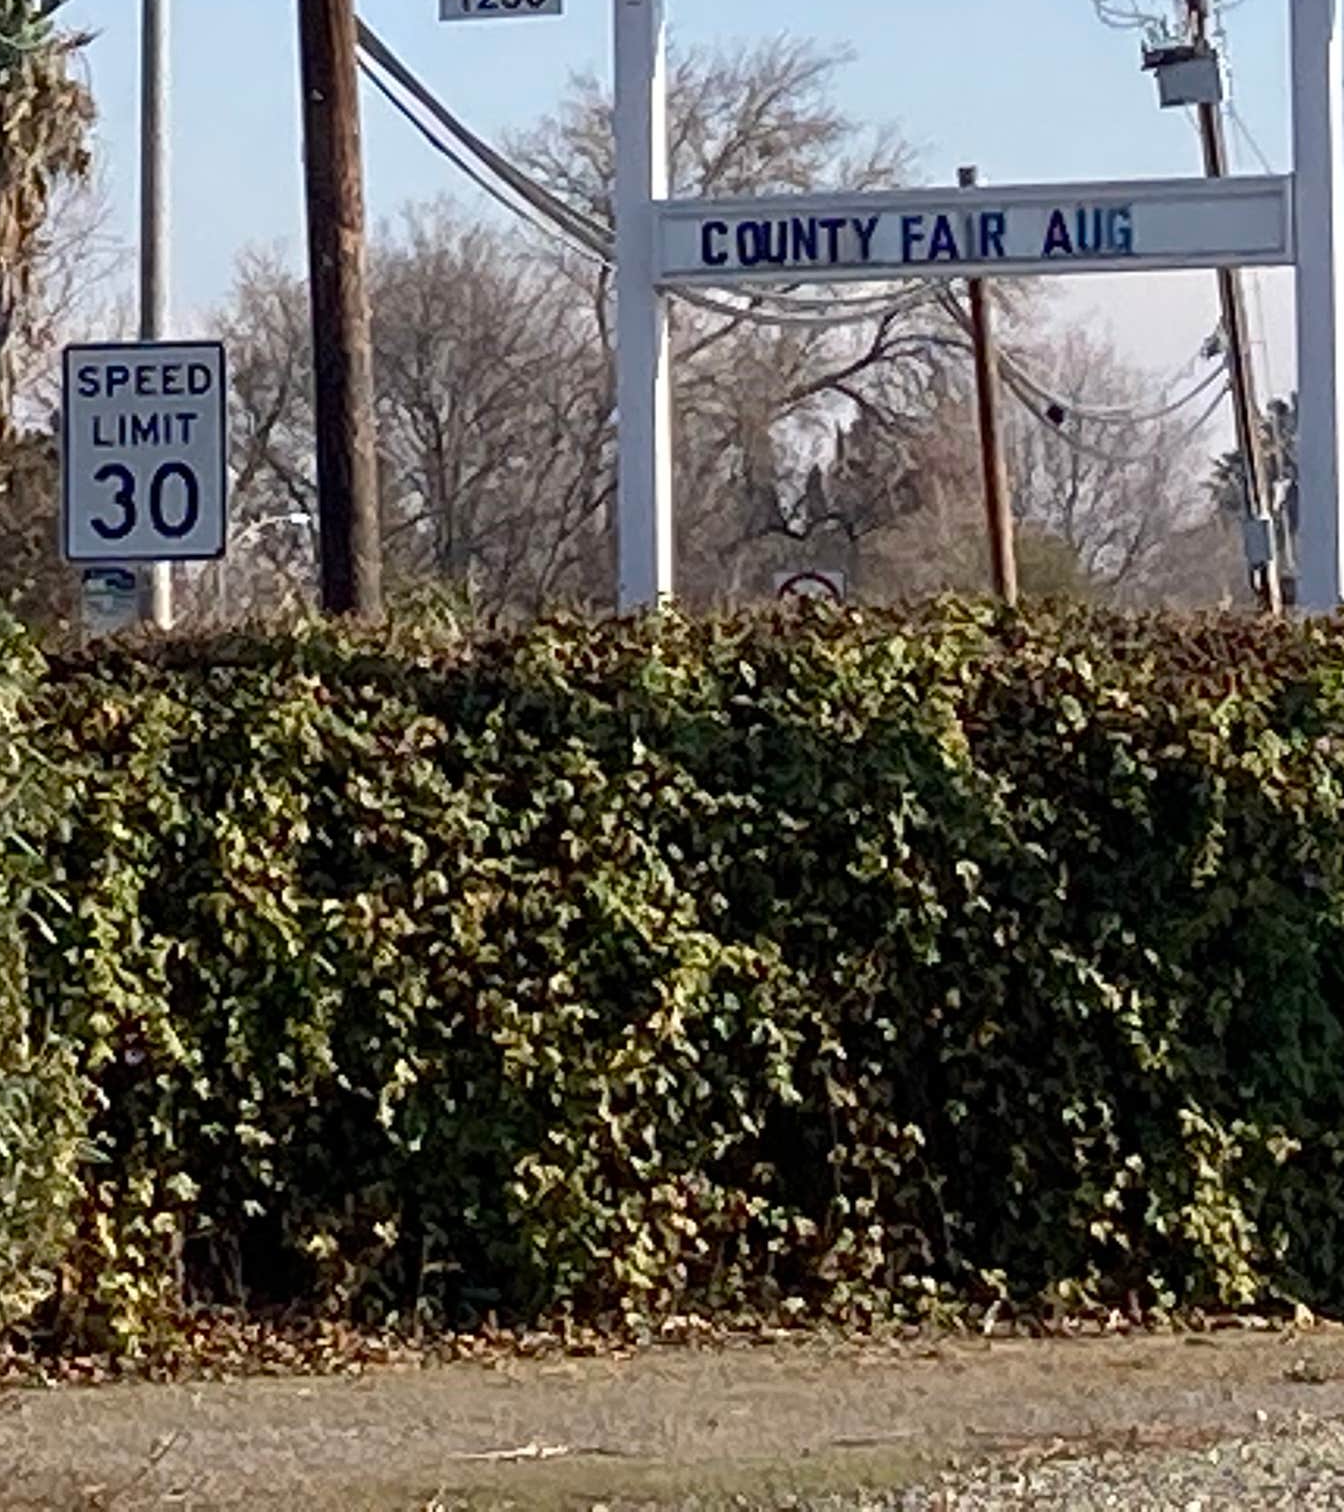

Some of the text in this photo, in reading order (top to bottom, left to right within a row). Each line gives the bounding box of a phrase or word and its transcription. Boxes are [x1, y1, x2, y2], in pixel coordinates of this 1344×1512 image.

[700, 204, 1133, 267] COUNTY FAIR AUG
[77, 363, 212, 397] SPEED
[92, 413, 198, 447] LIMIT
[90, 461, 199, 540] 30
